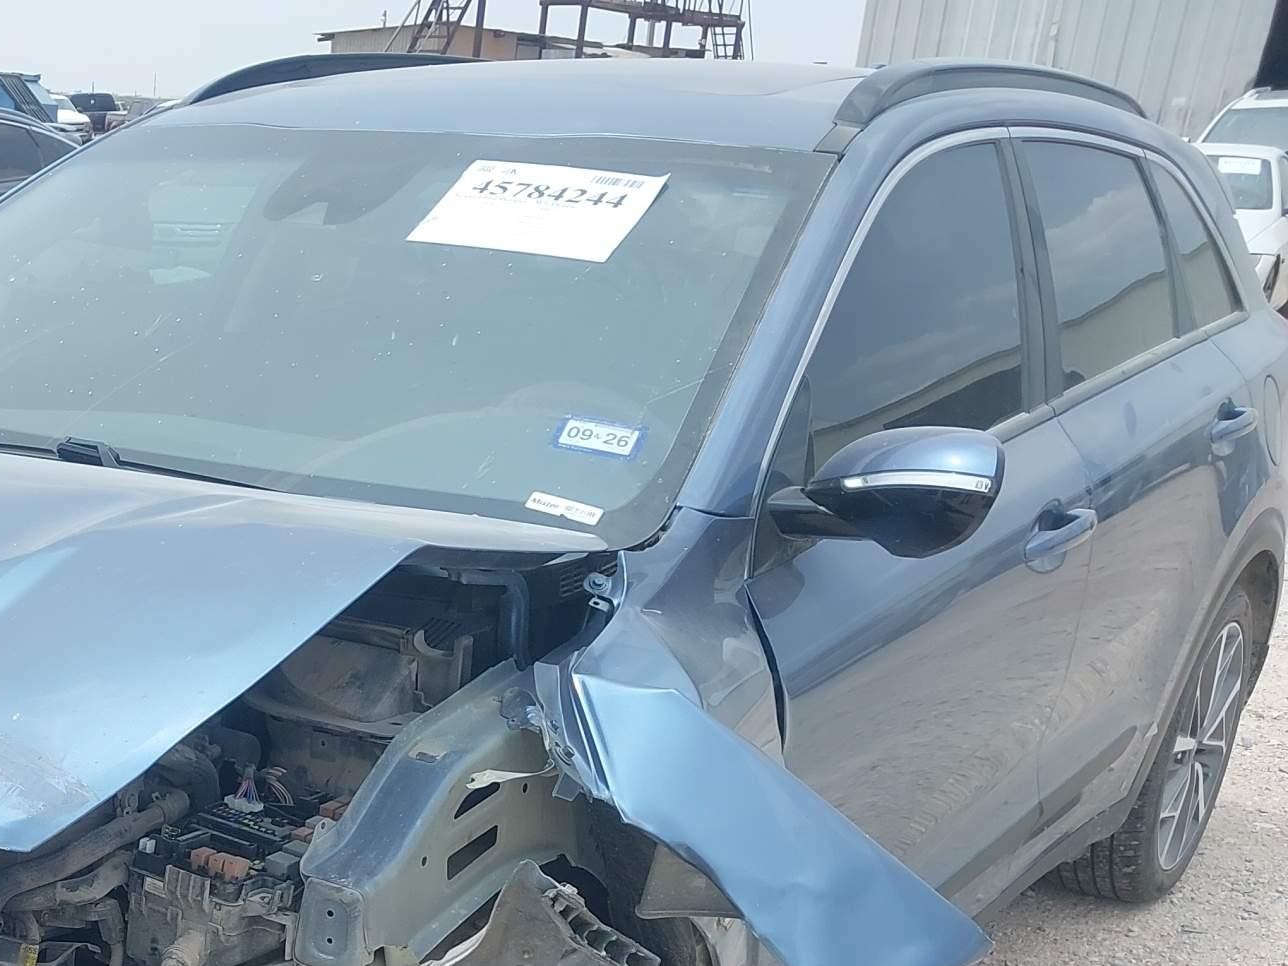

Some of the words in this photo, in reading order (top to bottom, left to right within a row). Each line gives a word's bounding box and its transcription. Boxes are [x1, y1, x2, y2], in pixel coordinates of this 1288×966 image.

[472, 178, 629, 209] 45784244
[566, 425, 594, 441] 09
[602, 432, 631, 448] 26
